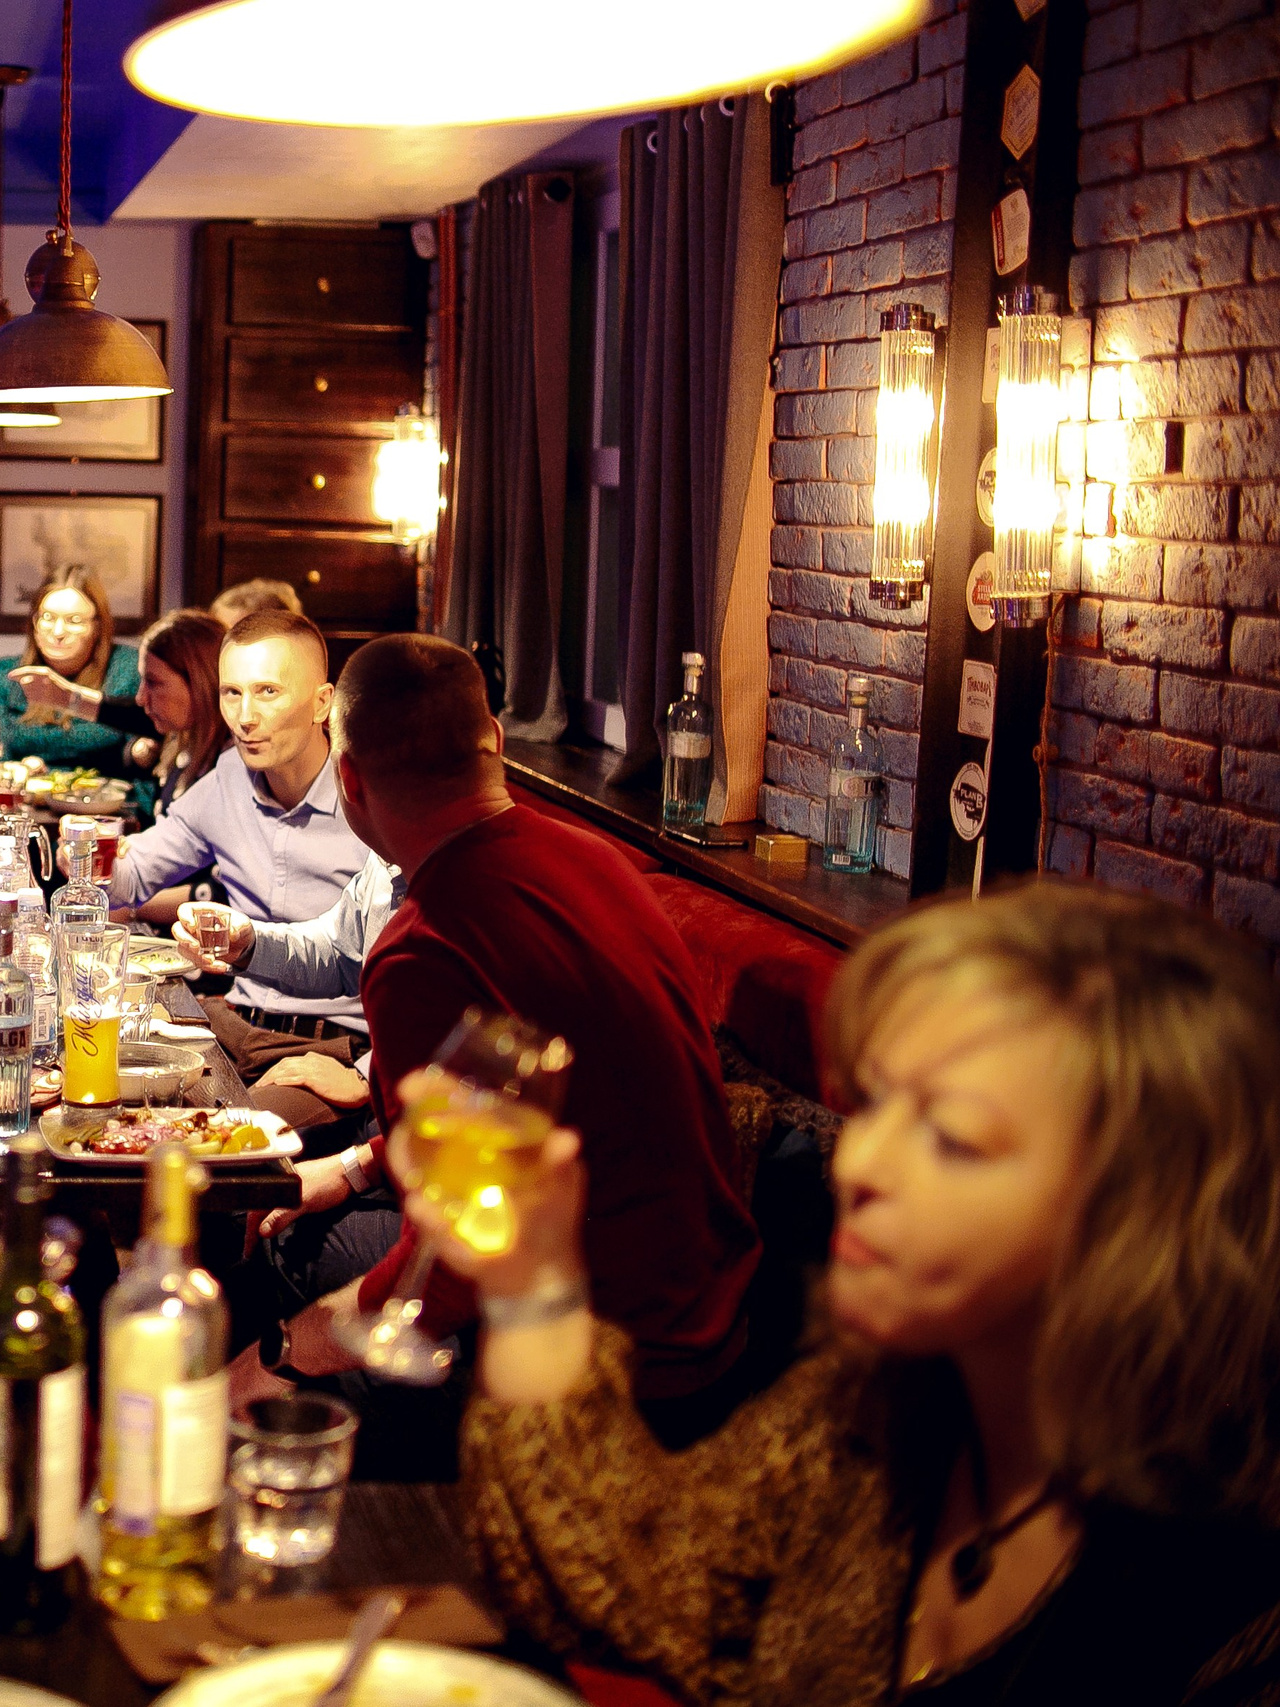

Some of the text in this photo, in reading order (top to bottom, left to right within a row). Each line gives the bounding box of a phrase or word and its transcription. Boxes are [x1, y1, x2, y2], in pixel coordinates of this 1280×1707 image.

[960, 788, 977, 800] PLAN
[976, 793, 983, 809] B
[70, 964, 103, 1057] Жигули
